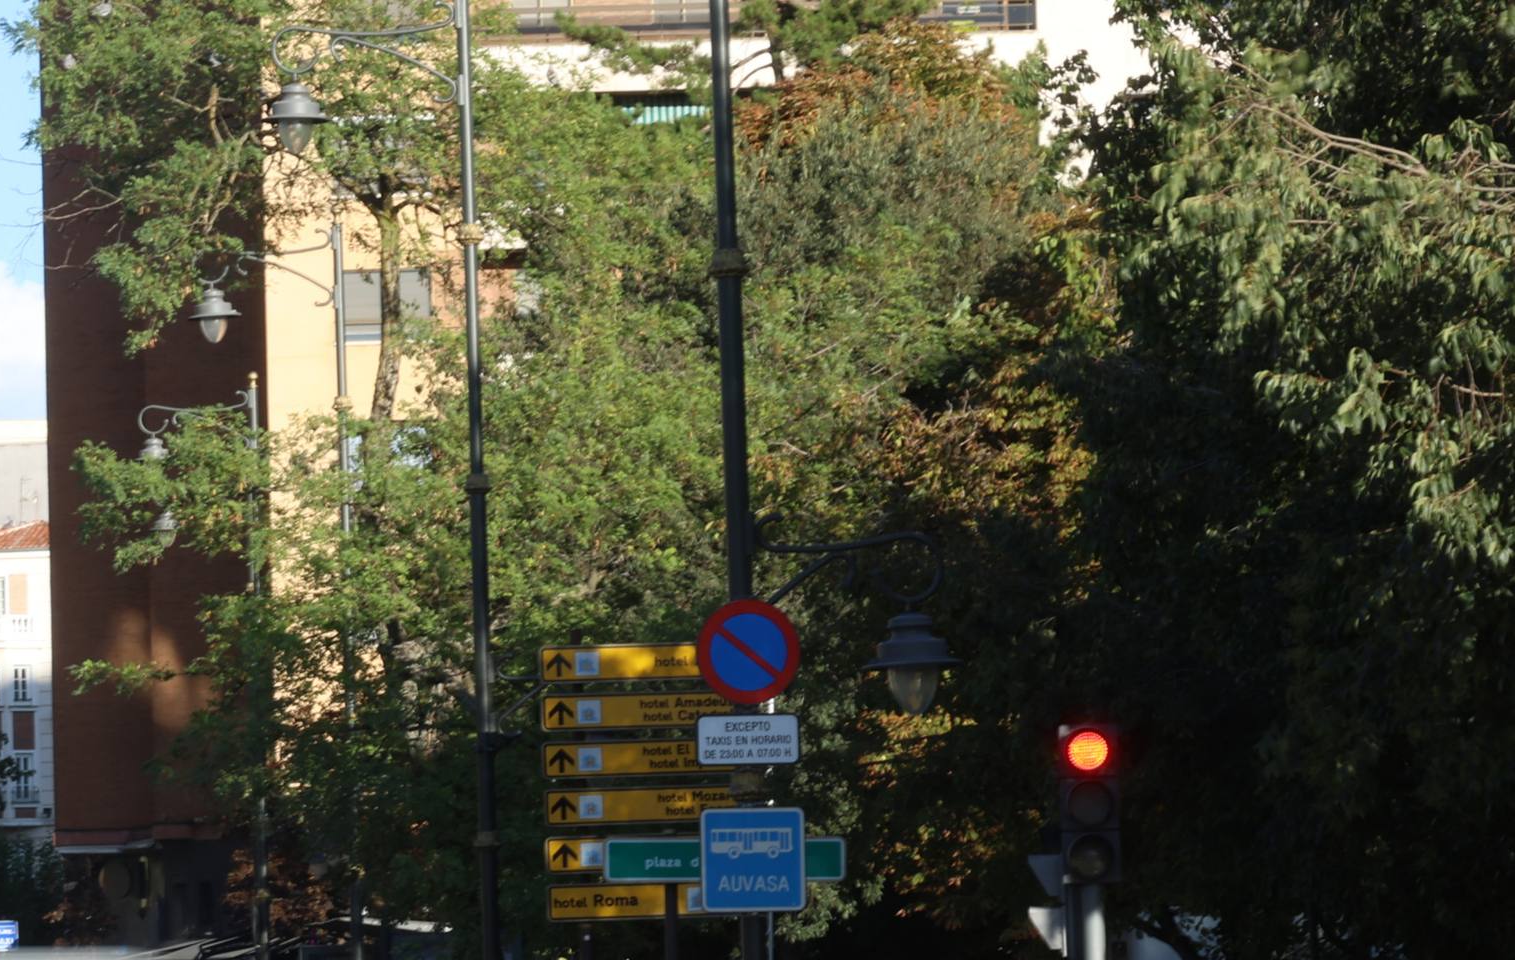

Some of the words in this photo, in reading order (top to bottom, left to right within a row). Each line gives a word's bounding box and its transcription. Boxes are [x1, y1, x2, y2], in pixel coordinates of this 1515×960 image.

[654, 656, 689, 667] hotel
[640, 700, 669, 709] hotel
[643, 712, 673, 722] hotel
[724, 721, 771, 733] EXCEPTO
[705, 736, 732, 746] TAXIS
[735, 735, 748, 745] EN
[751, 734, 792, 745] HORARIO
[643, 745, 672, 755] hotel
[704, 750, 716, 759] DE
[747, 749, 754, 758] A
[649, 758, 679, 768] hotel
[657, 792, 687, 803] hotel
[666, 806, 695, 816] hotel
[645, 856, 682, 870] plaza
[718, 874, 790, 892] AUVASA
[553, 896, 587, 909] hotel
[593, 893, 639, 907] Roma
